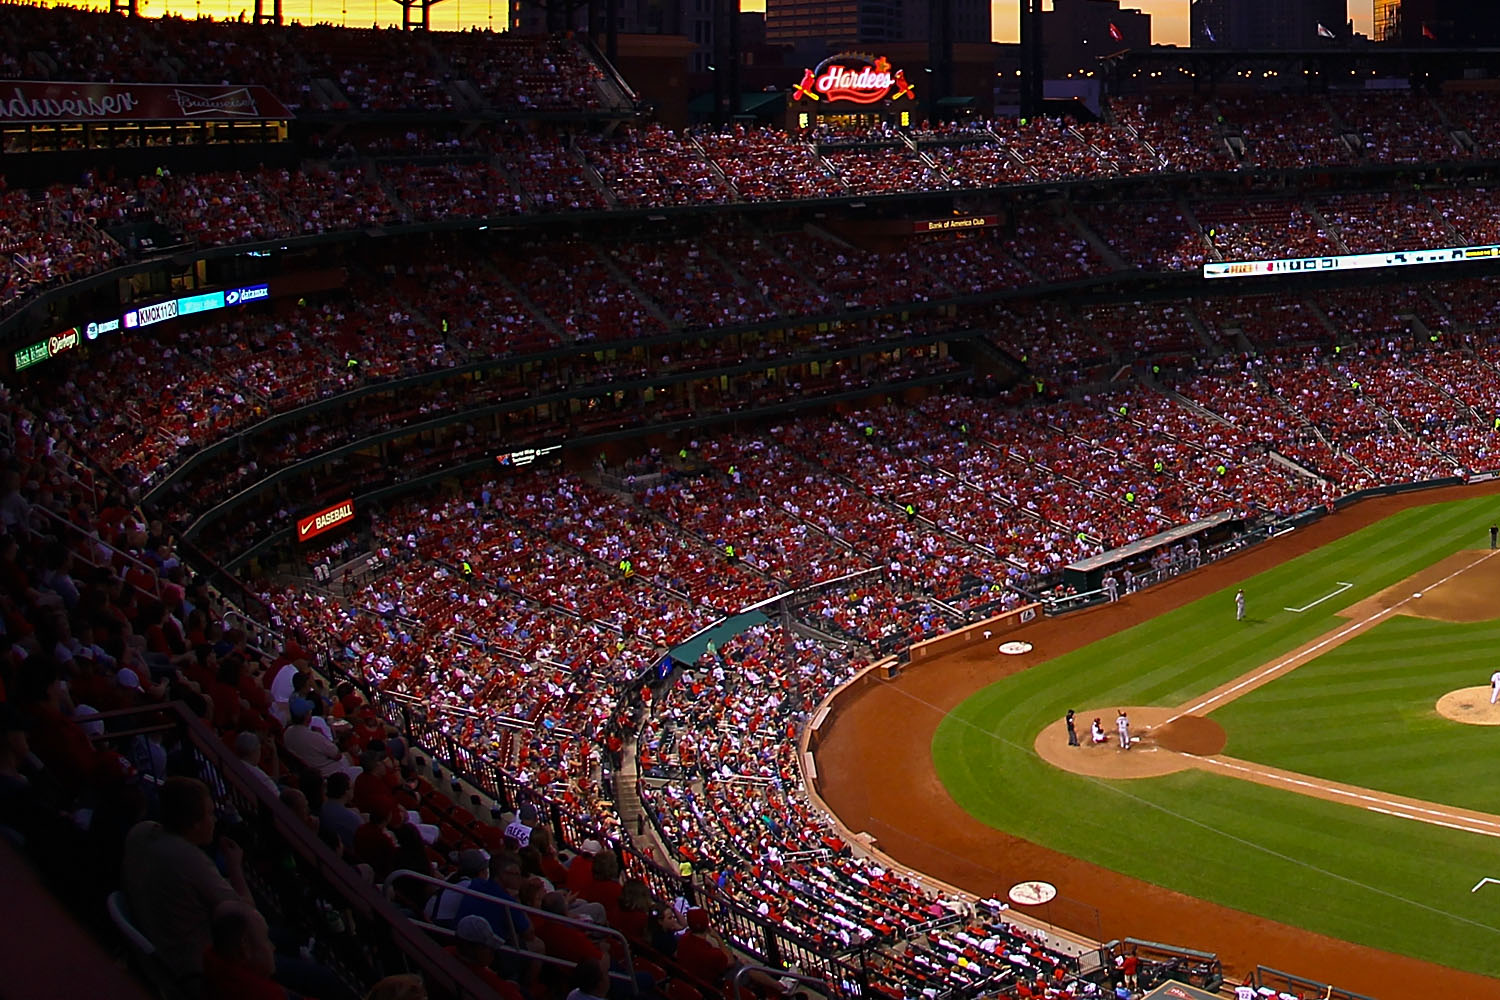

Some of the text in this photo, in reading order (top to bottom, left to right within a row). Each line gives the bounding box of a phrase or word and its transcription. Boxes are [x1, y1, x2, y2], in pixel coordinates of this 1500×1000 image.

[168, 94, 255, 109] Budweiser
[928, 218, 985, 230] Bank of America Club
[315, 504, 353, 530] BASEBALL
